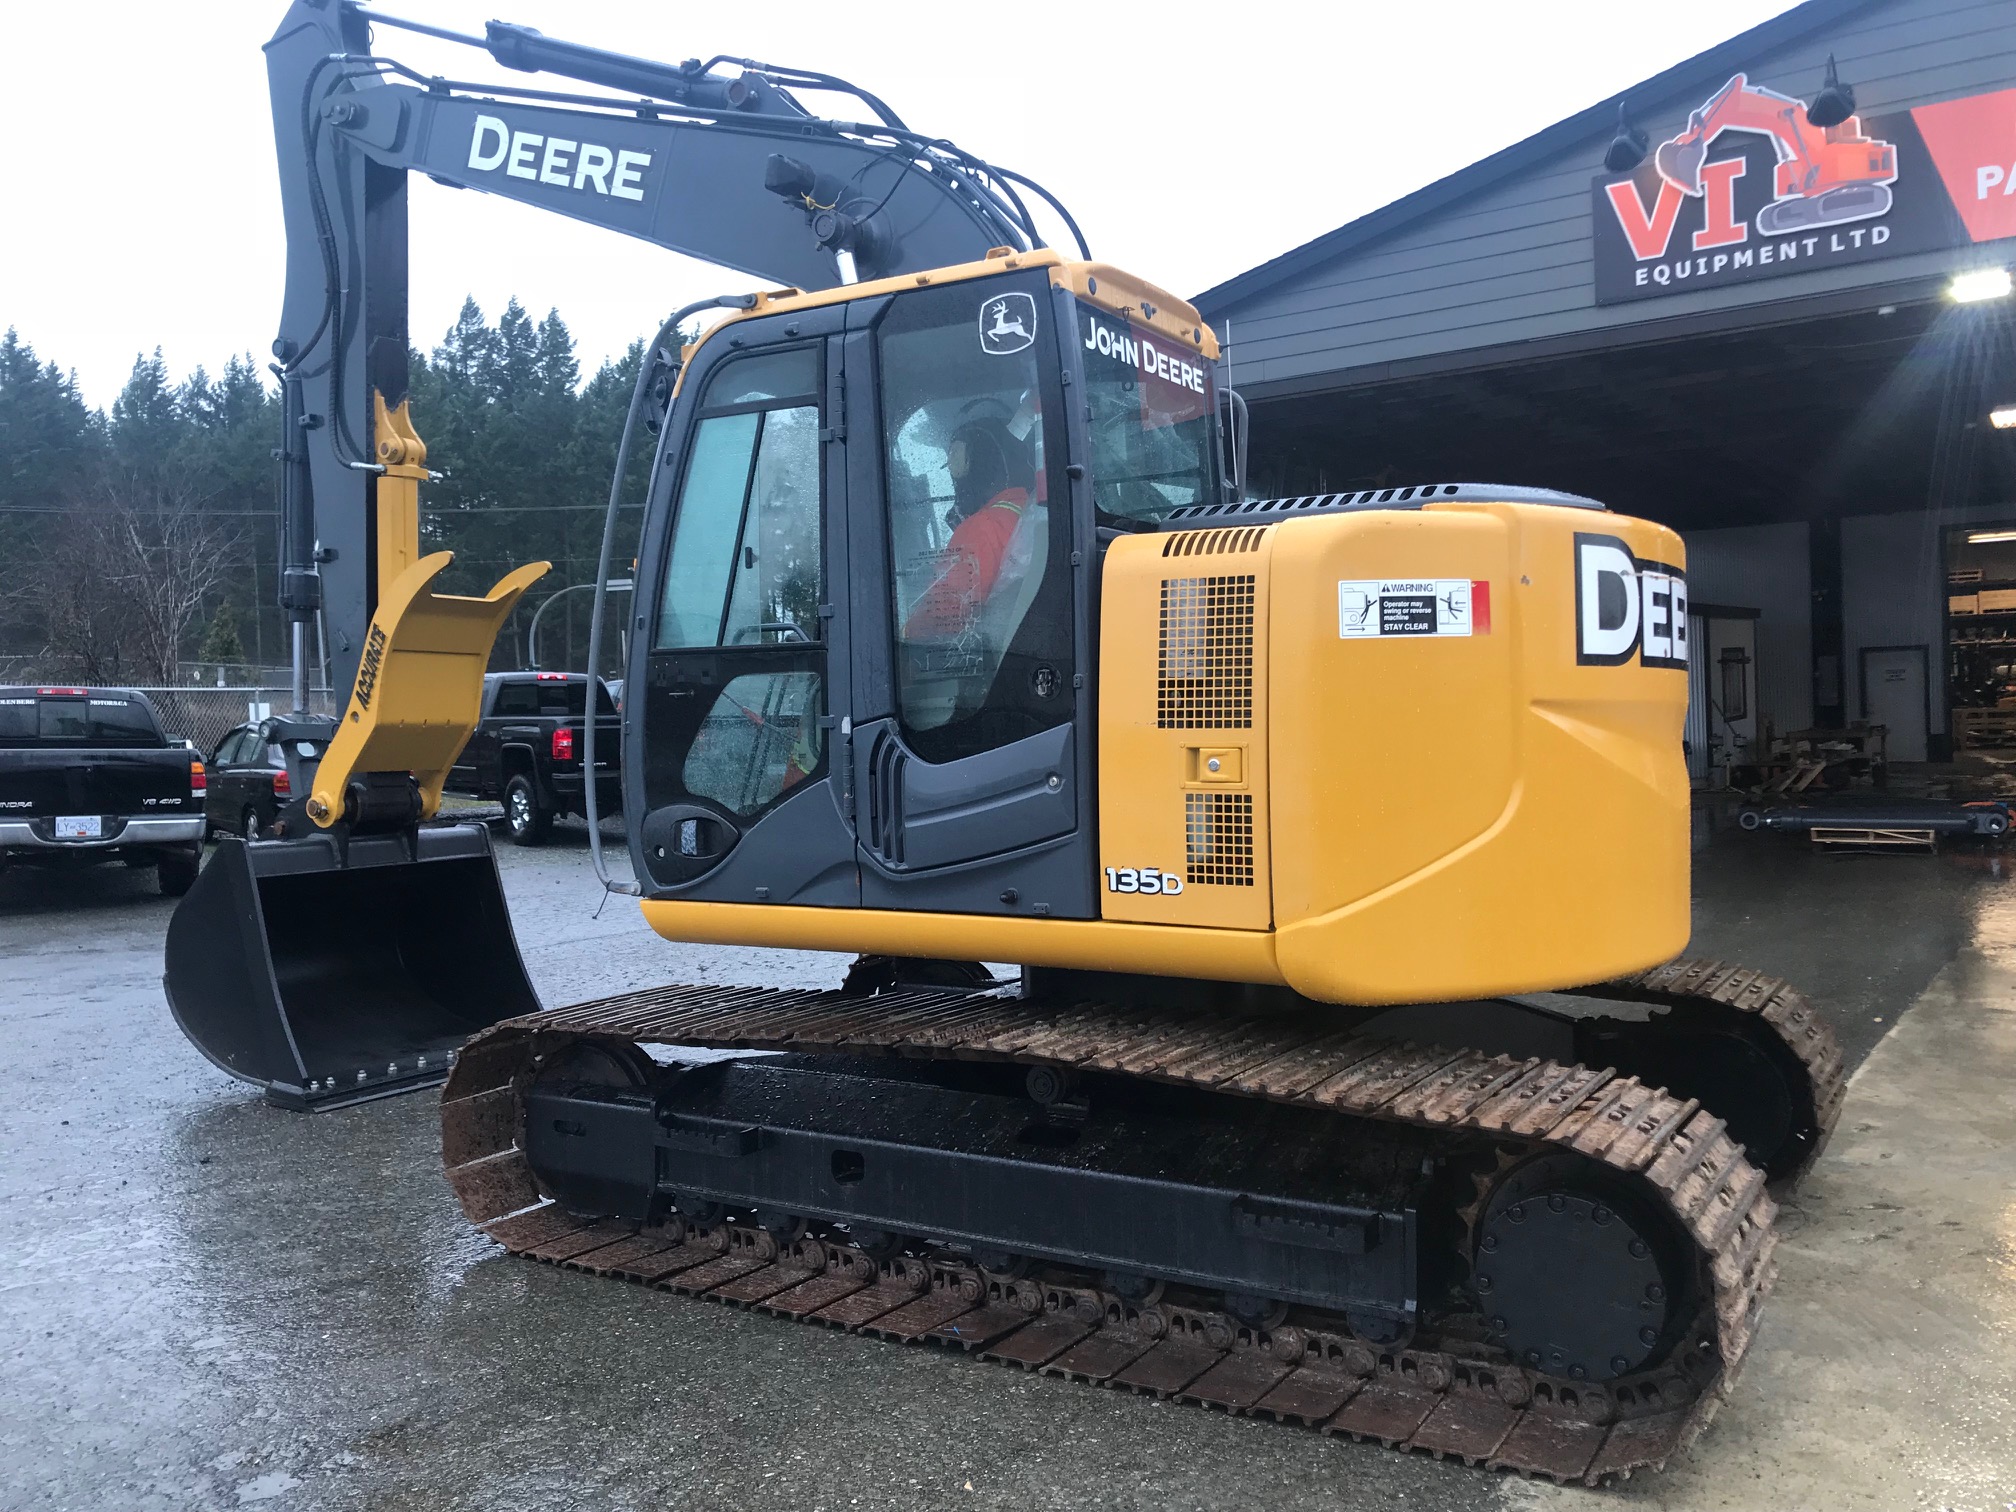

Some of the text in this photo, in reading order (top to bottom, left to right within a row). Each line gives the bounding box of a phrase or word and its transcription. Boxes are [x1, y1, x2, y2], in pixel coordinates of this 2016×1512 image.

[468, 114, 652, 201] DEERE
[1634, 226, 1891, 286] EQUIPMENT LTD
[1085, 316, 1205, 394] JOHN DEERE
[1383, 601, 1424, 609] Operator may
[1391, 583, 1434, 593] WARNING
[1384, 622, 1429, 631] STAY CLEAR
[355, 622, 387, 712] ACCURATE
[1105, 865, 1185, 896] 135D
